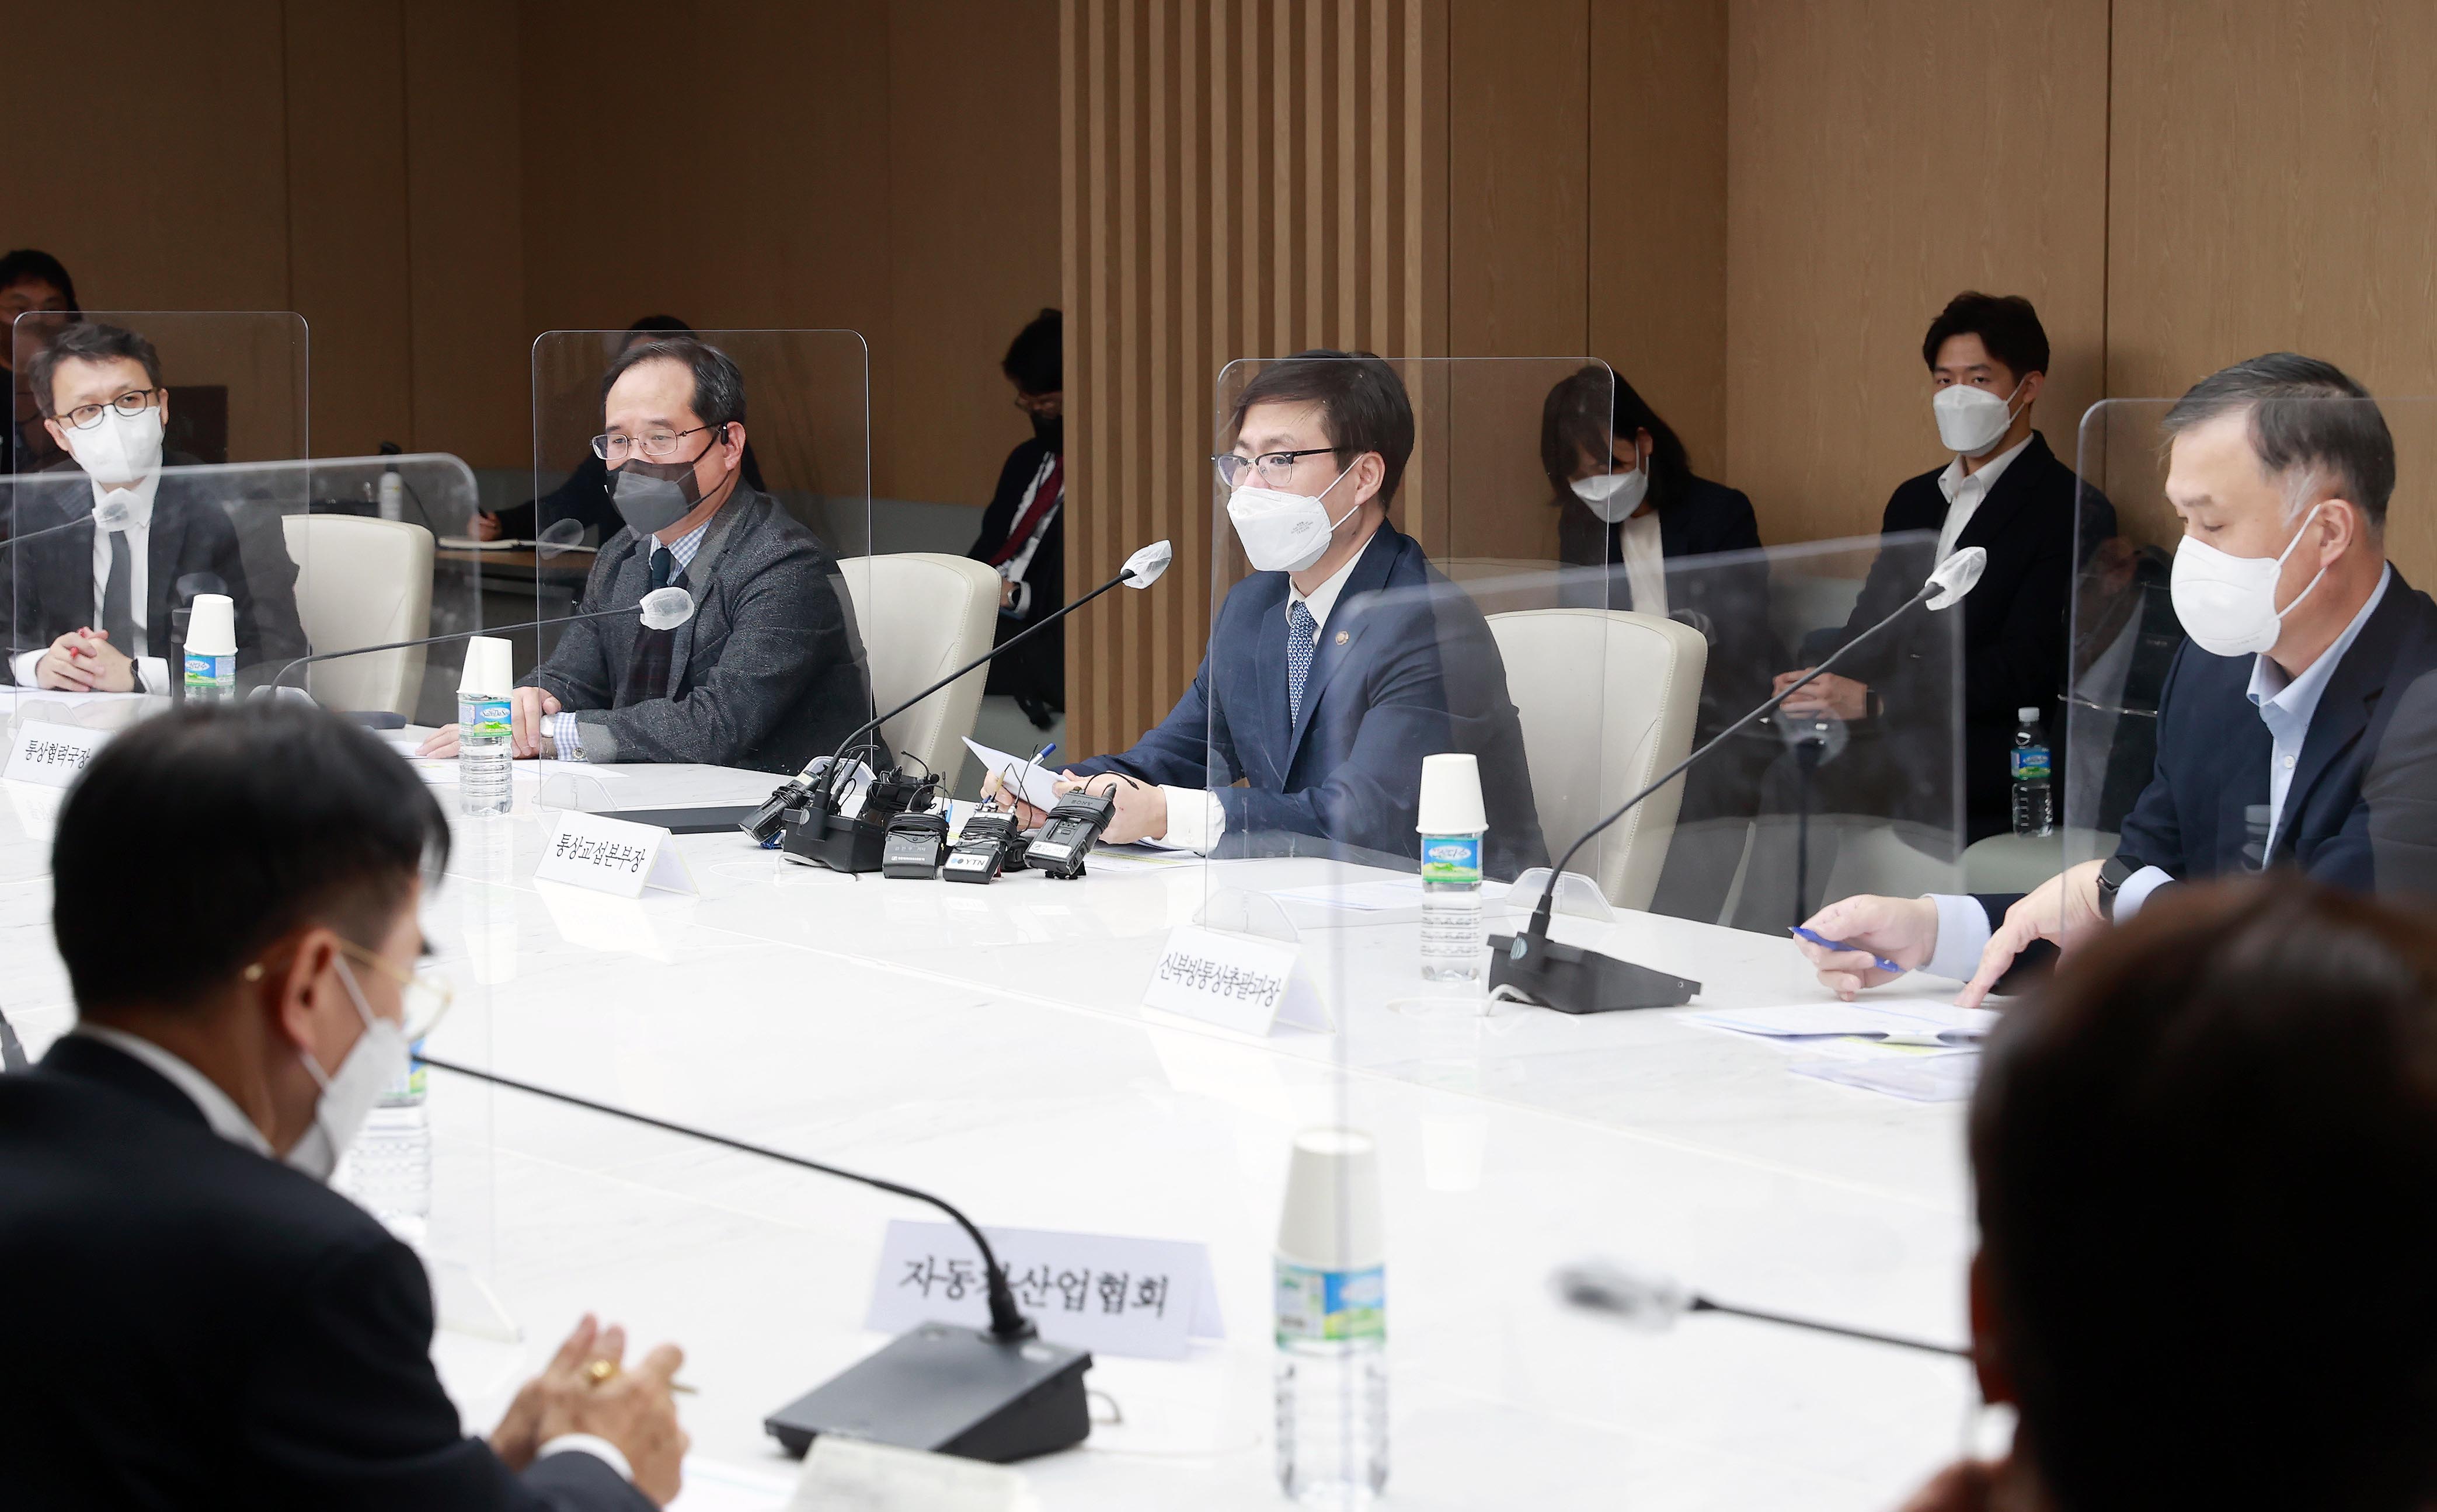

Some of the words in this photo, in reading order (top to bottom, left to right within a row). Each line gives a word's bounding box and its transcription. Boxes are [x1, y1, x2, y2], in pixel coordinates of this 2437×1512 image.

[25, 739, 90, 769] 통상협력국장
[556, 834, 645, 872] 통상교섭본부장
[1160, 952, 1281, 1007] 신북방통상총괄과장
